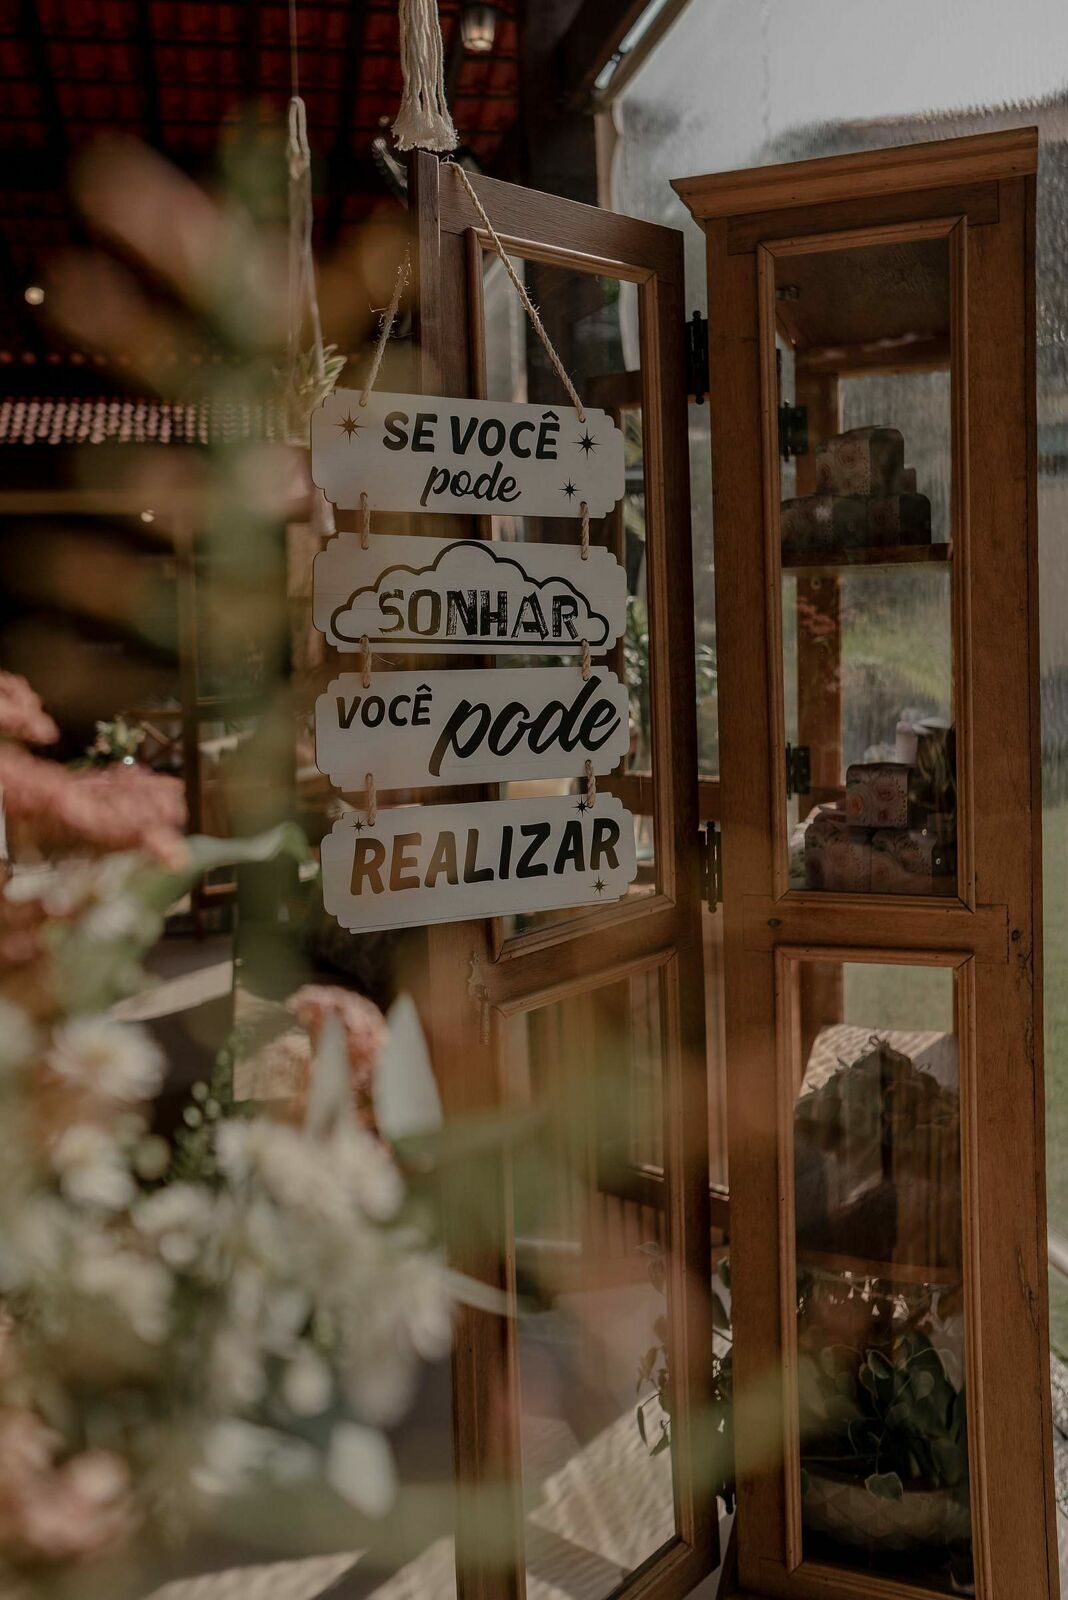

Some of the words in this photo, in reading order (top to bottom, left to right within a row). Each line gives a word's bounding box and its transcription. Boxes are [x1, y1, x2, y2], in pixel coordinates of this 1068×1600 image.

[382, 411, 438, 453] SE
[449, 410, 561, 460] VOCÊ
[419, 461, 522, 507] pode
[378, 588, 580, 641] SONHAR
[336, 683, 433, 729] VOCÊ
[428, 675, 621, 777] pode
[350, 817, 621, 896] REALIZAR
